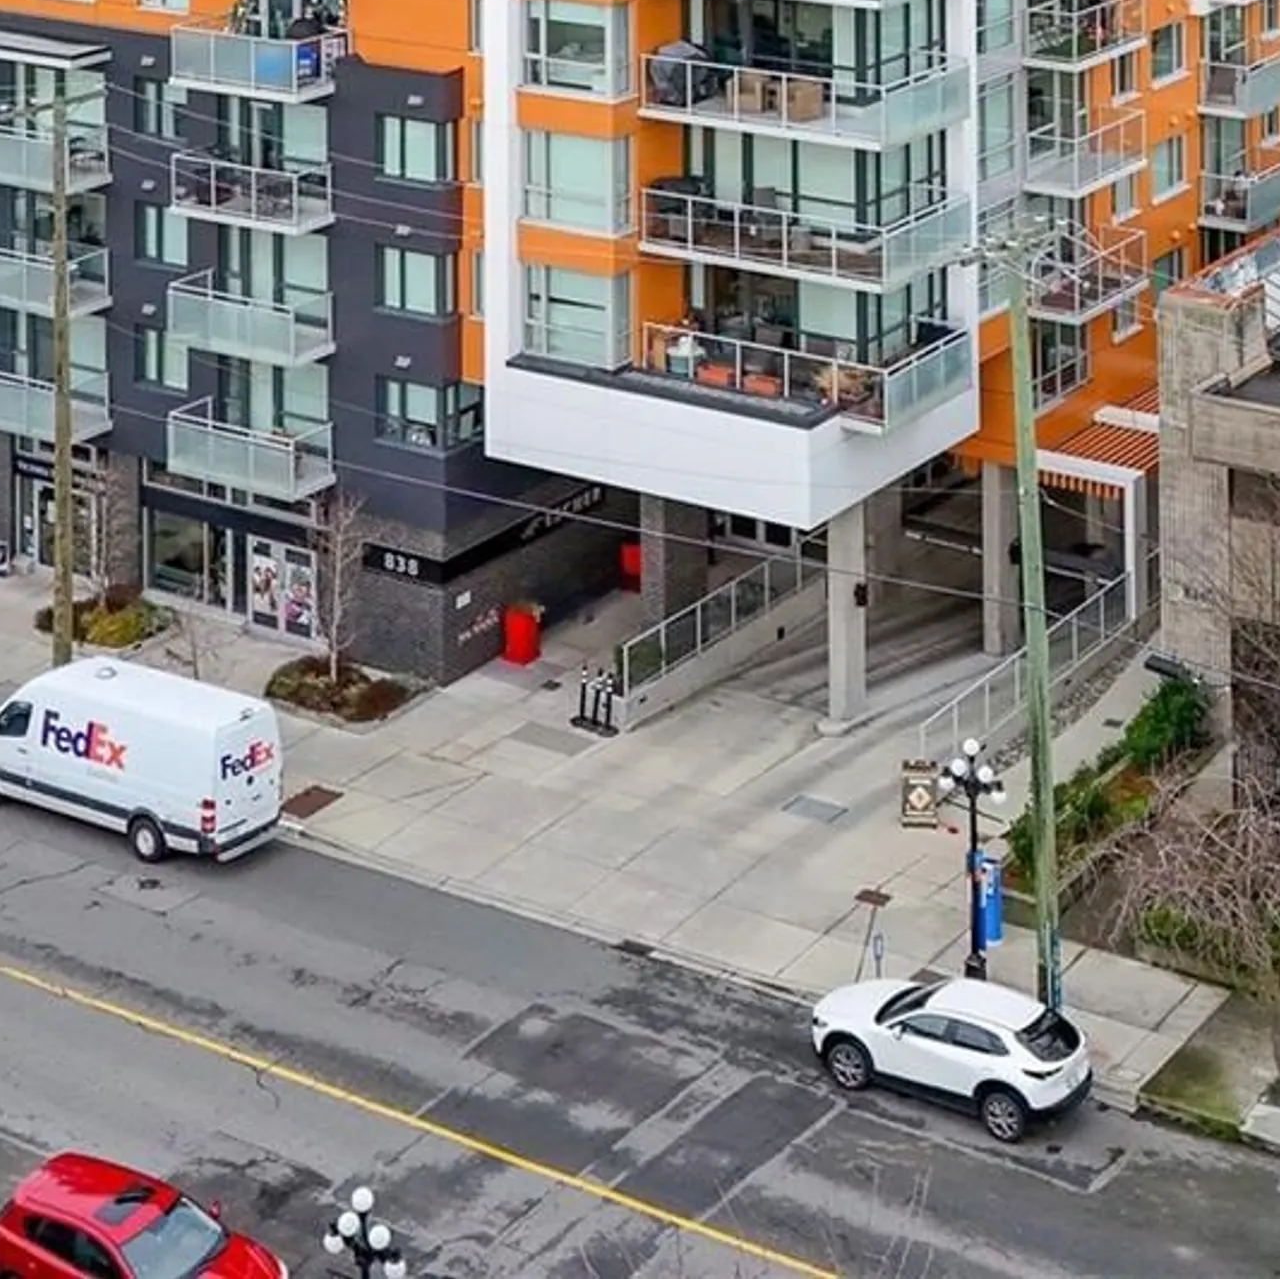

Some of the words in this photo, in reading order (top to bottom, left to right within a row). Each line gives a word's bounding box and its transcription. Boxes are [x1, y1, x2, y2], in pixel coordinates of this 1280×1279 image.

[383, 552, 419, 576] 838
[40, 709, 128, 770] FedEx
[220, 740, 275, 781] FedEx
